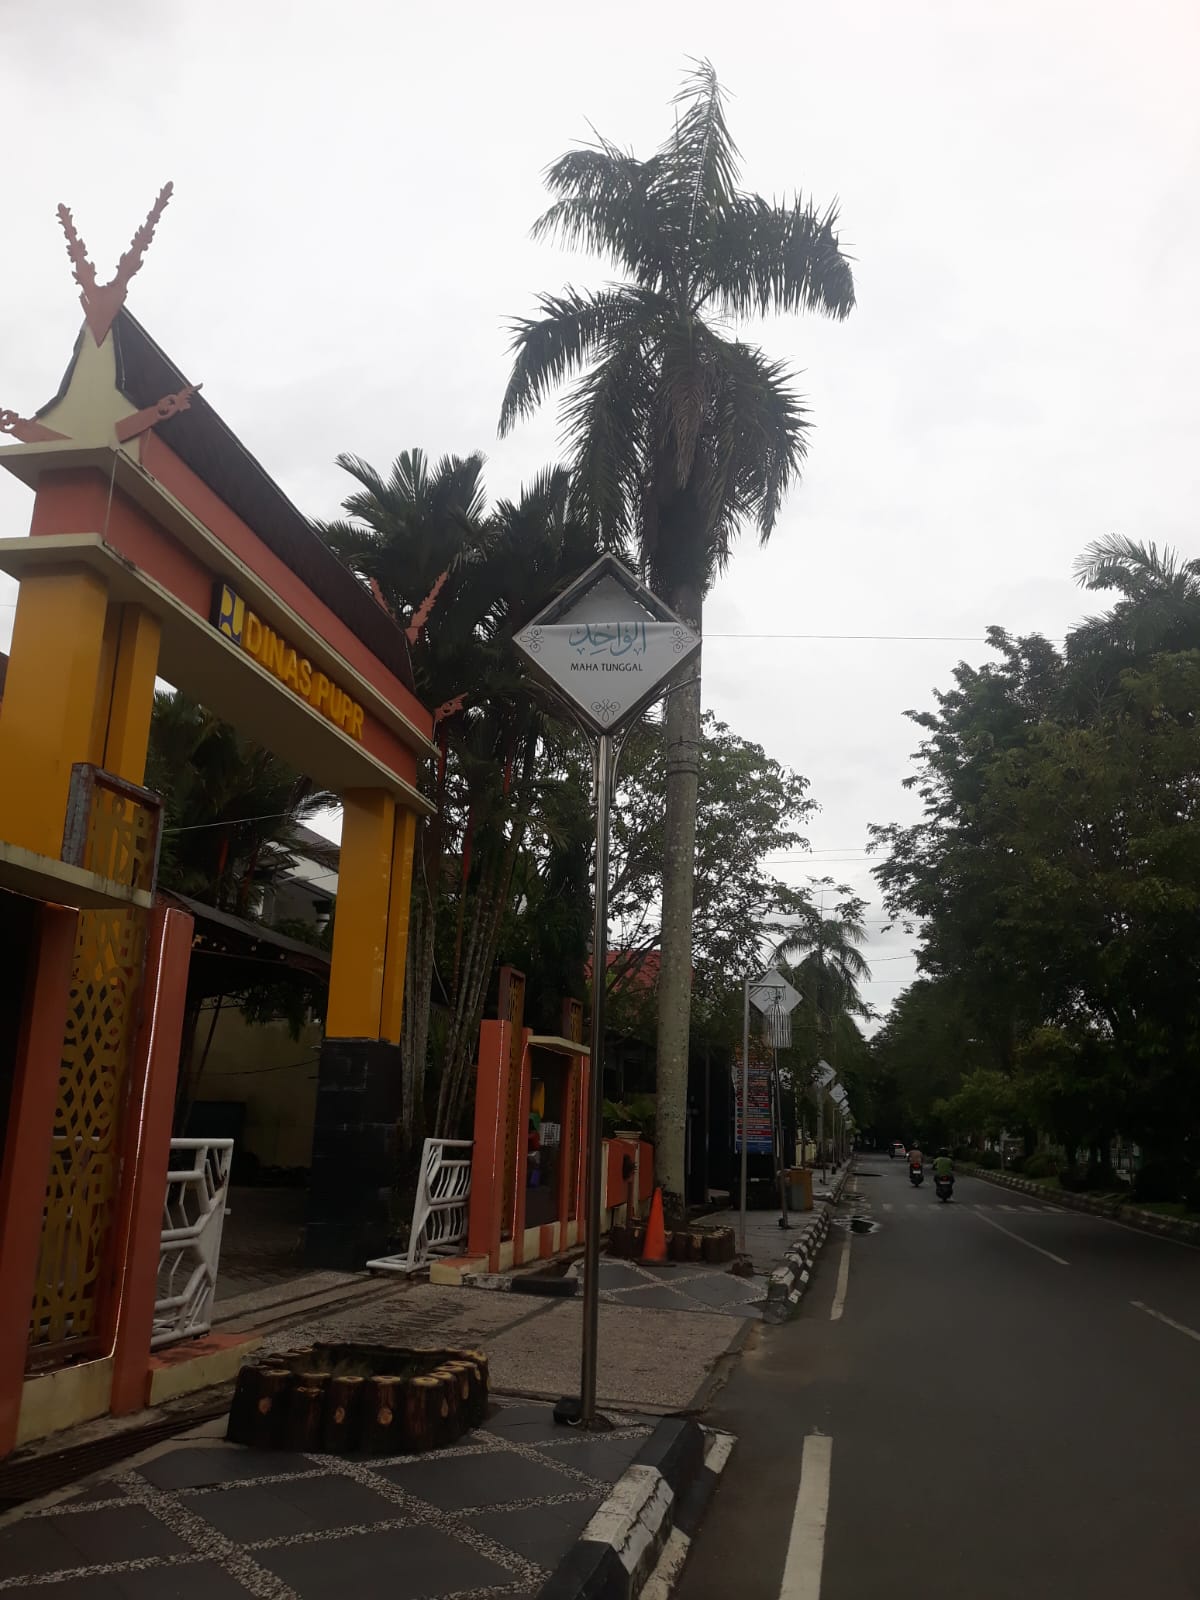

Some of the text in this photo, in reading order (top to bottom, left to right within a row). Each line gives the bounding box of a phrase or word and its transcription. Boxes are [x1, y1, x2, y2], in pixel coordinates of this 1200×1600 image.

[244, 612, 365, 741] DINAS PUPR
[570, 663, 643, 672] MAHA TUNGGAL
